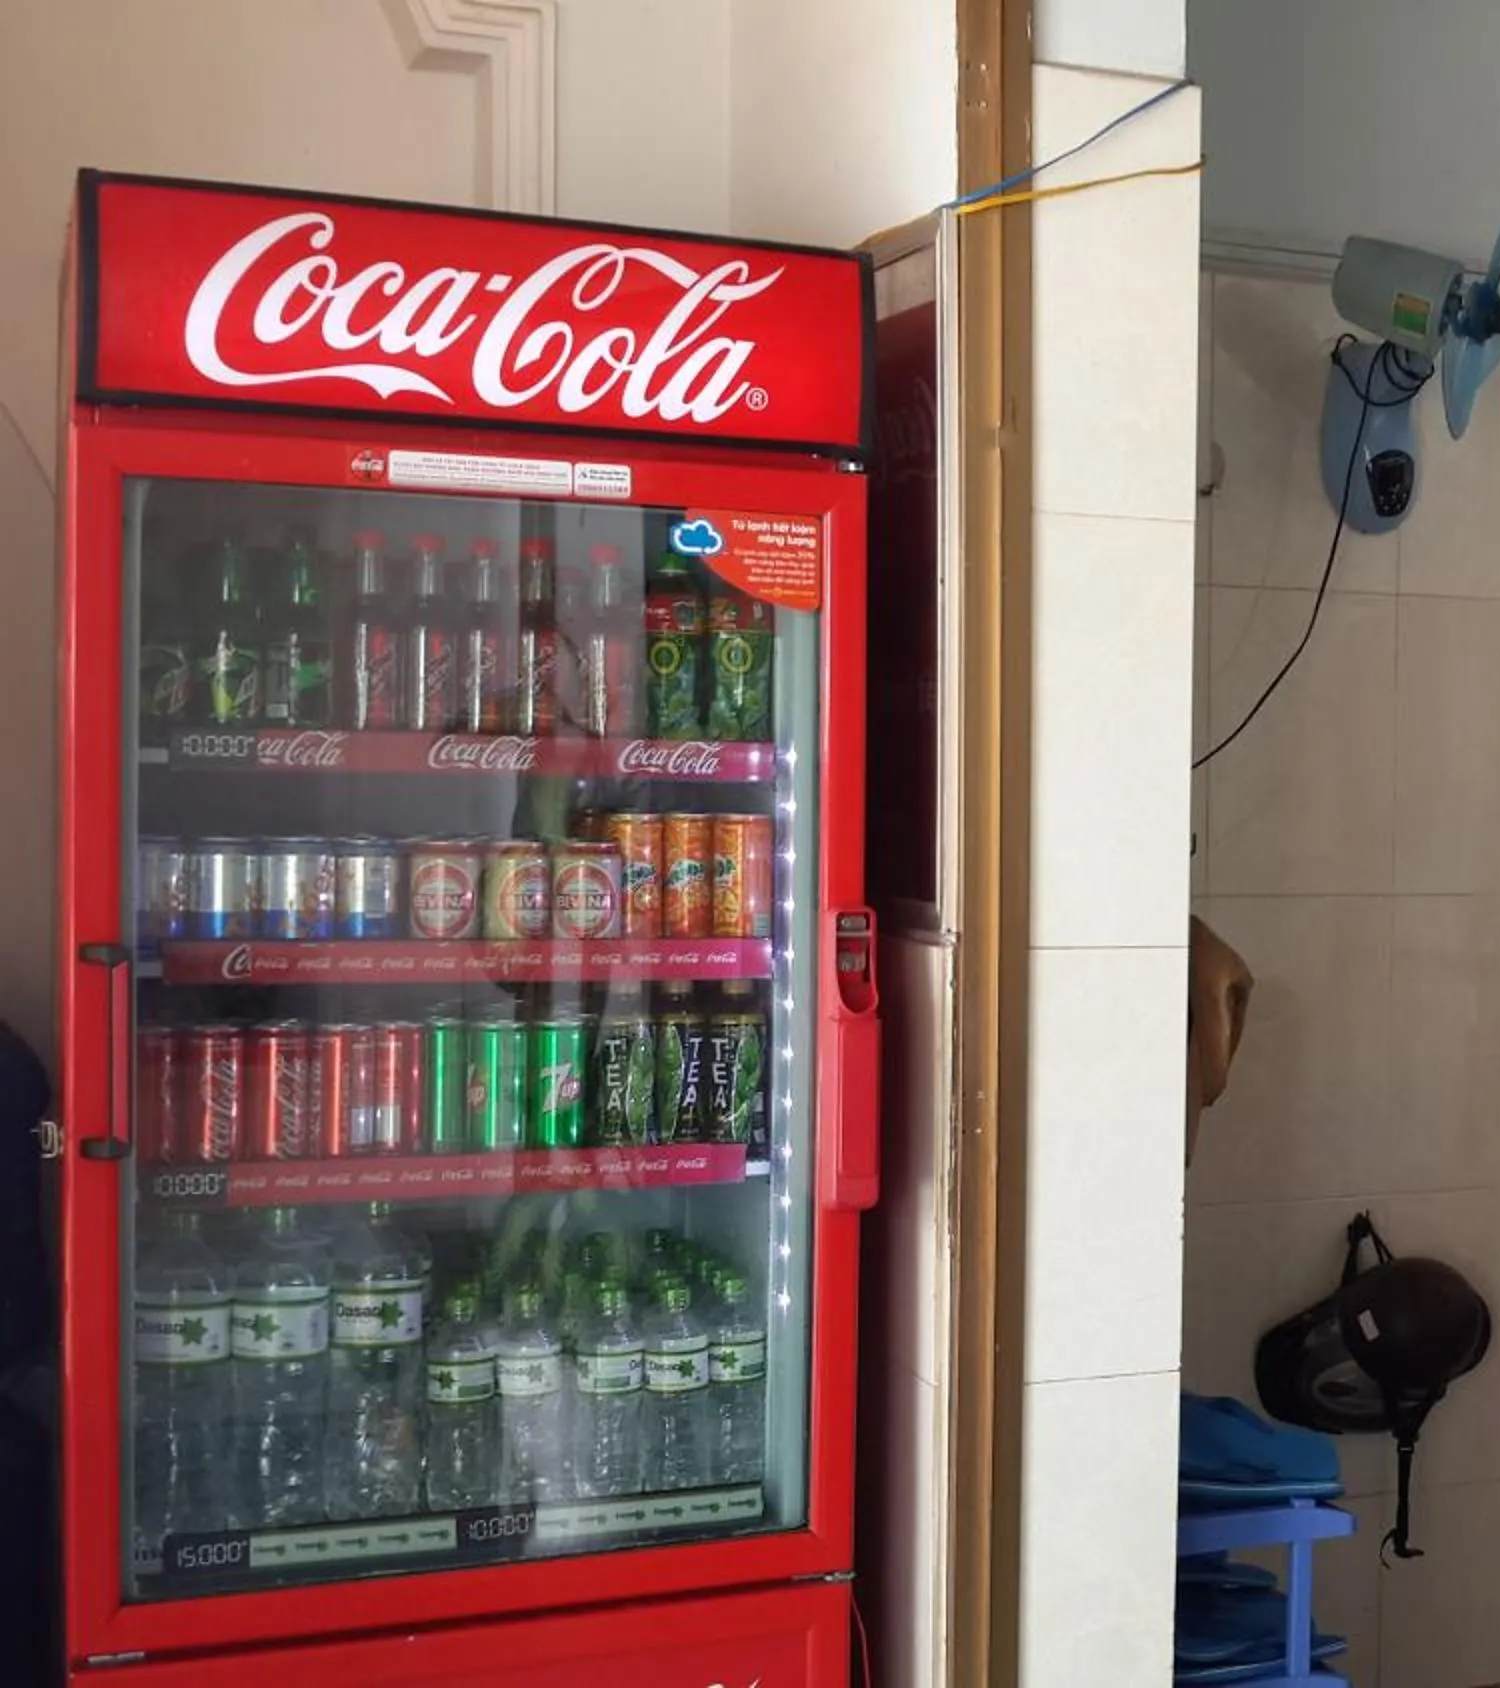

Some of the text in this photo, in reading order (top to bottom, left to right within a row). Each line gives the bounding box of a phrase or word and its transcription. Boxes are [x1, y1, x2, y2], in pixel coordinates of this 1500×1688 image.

[185, 212, 785, 423] Coca-Cola
[257, 730, 350, 767] ca-Cola
[617, 739, 724, 774] Coca-Cola
[711, 1038, 729, 1109] TEA
